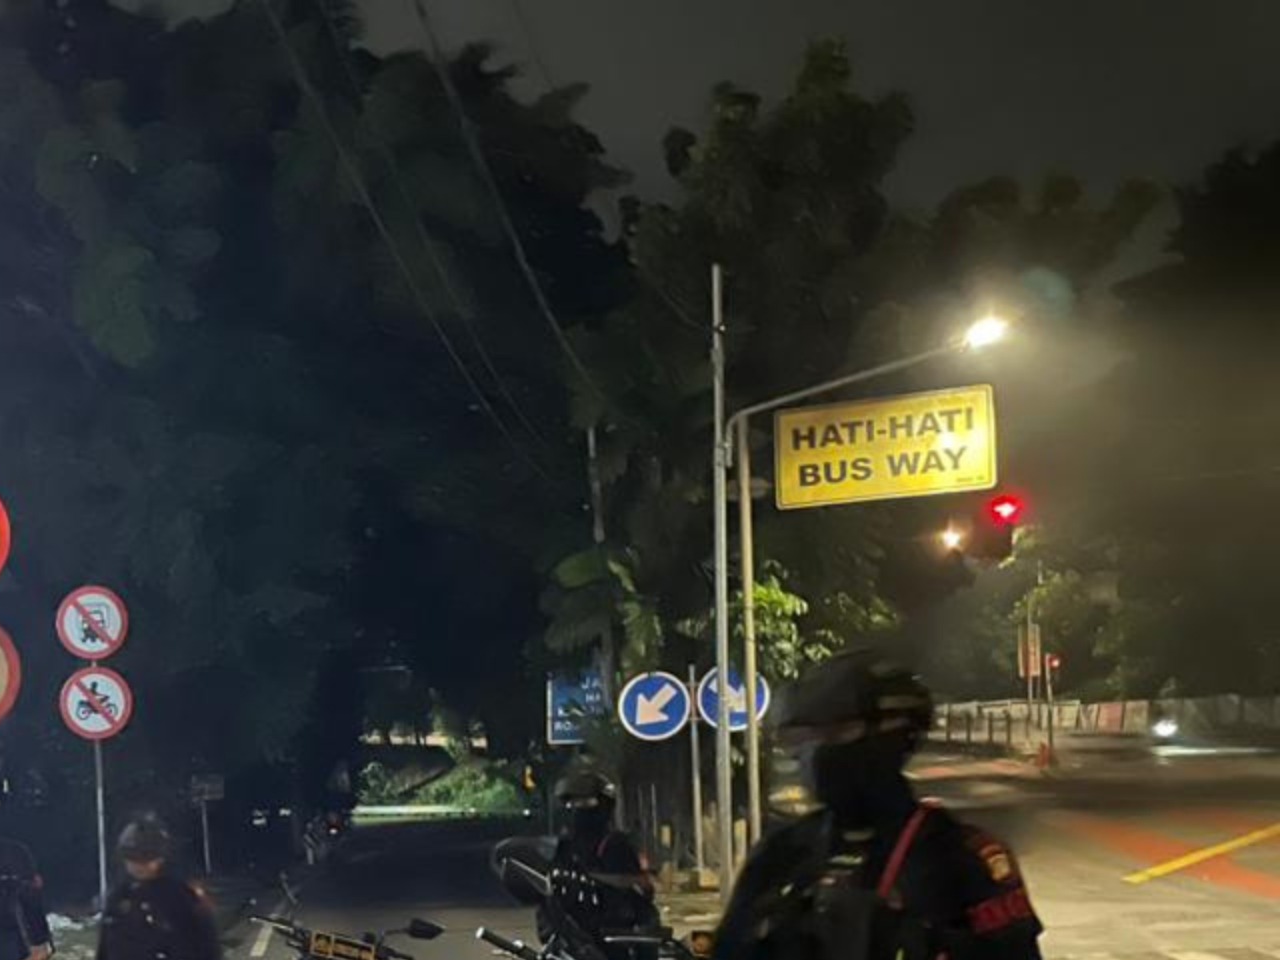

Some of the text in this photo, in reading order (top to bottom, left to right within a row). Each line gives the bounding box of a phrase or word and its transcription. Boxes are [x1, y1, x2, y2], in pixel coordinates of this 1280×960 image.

[792, 407, 974, 450] HATI-HATI
[798, 446, 968, 487] BUS WAY
